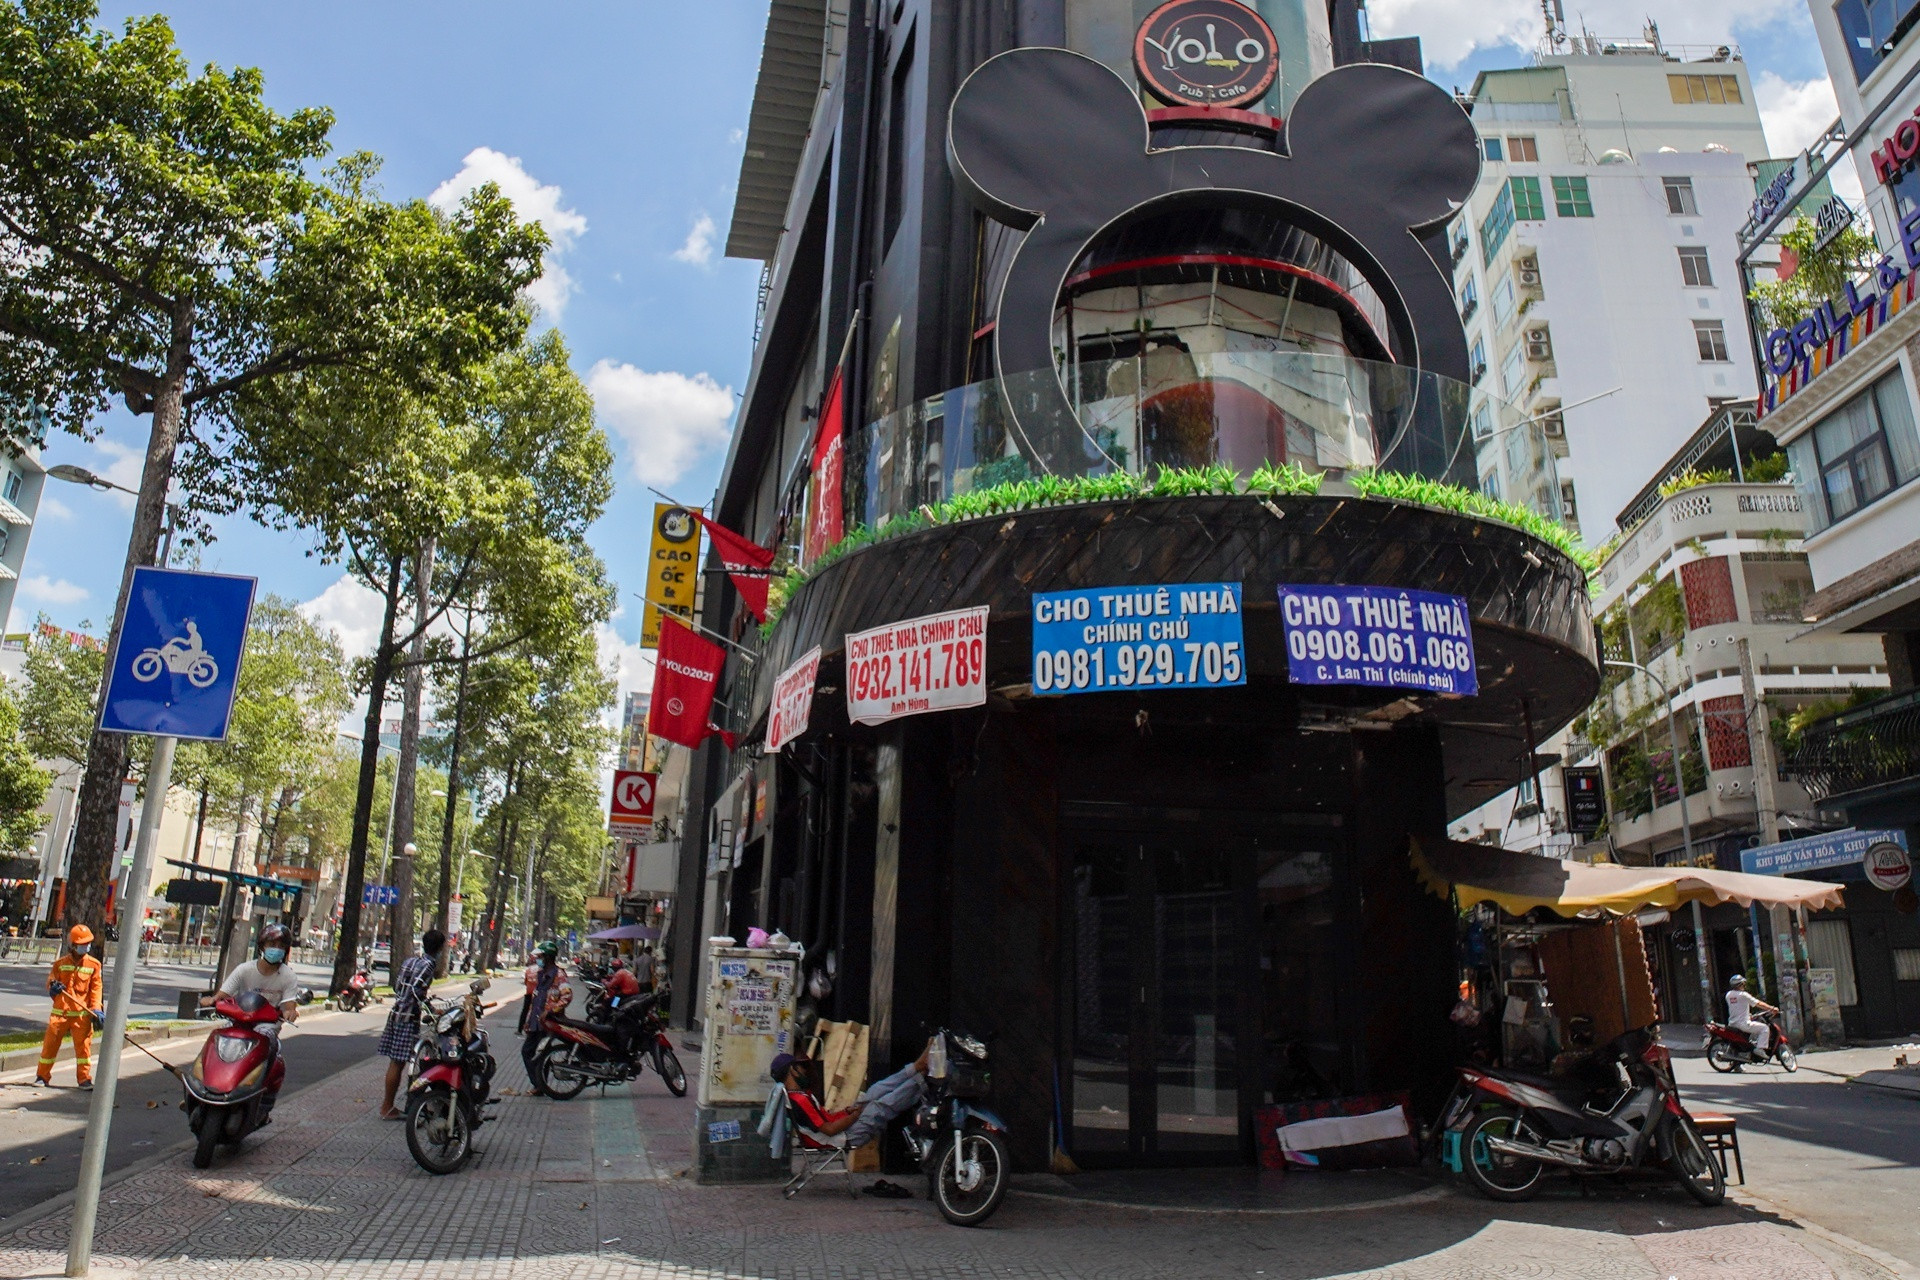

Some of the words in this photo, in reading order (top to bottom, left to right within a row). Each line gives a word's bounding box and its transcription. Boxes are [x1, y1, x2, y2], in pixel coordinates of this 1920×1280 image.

[1145, 24, 1264, 70] YOLO
[1178, 84, 1203, 97] Pub
[1219, 85, 1247, 98] Cafe
[1871, 105, 1920, 184] HO
[1766, 280, 1876, 375] GRILL
[1876, 255, 1905, 290] &
[656, 550, 691, 562] CAO
[661, 566, 685, 583] ỐC
[664, 586, 675, 597] &
[1036, 597, 1090, 623] CHO
[1099, 588, 1170, 617] THUÊ
[1181, 585, 1238, 614] NHÀ
[1083, 620, 1142, 644] CHÍNH
[1149, 615, 1189, 640] CHỦ
[1284, 595, 1341, 626] CHO
[1347, 592, 1414, 630] THUÊ
[1420, 598, 1467, 637] NHÀ
[851, 641, 869, 659] CHO
[872, 628, 893, 655] THUÊ
[896, 623, 918, 651] NHÀ
[922, 618, 954, 645] CHÍNH
[958, 611, 983, 638] CHỦ
[1289, 630, 1471, 672] 0908.061.068
[850, 639, 982, 703] 0932.141.789
[1036, 642, 1241, 690] 0981.929.705
[1317, 665, 1332, 680] C.
[1337, 665, 1360, 681] Lan
[1389, 667, 1426, 685] (chính
[1429, 674, 1453, 692] chủ)
[891, 701, 906, 714] Anh
[908, 698, 929, 711] Hùng
[1756, 857, 1773, 868] KHU
[1775, 850, 1792, 865] PHỐ
[1794, 849, 1813, 861] VĂN
[1815, 844, 1835, 857] HÓA
[1843, 839, 1865, 852] KHU
